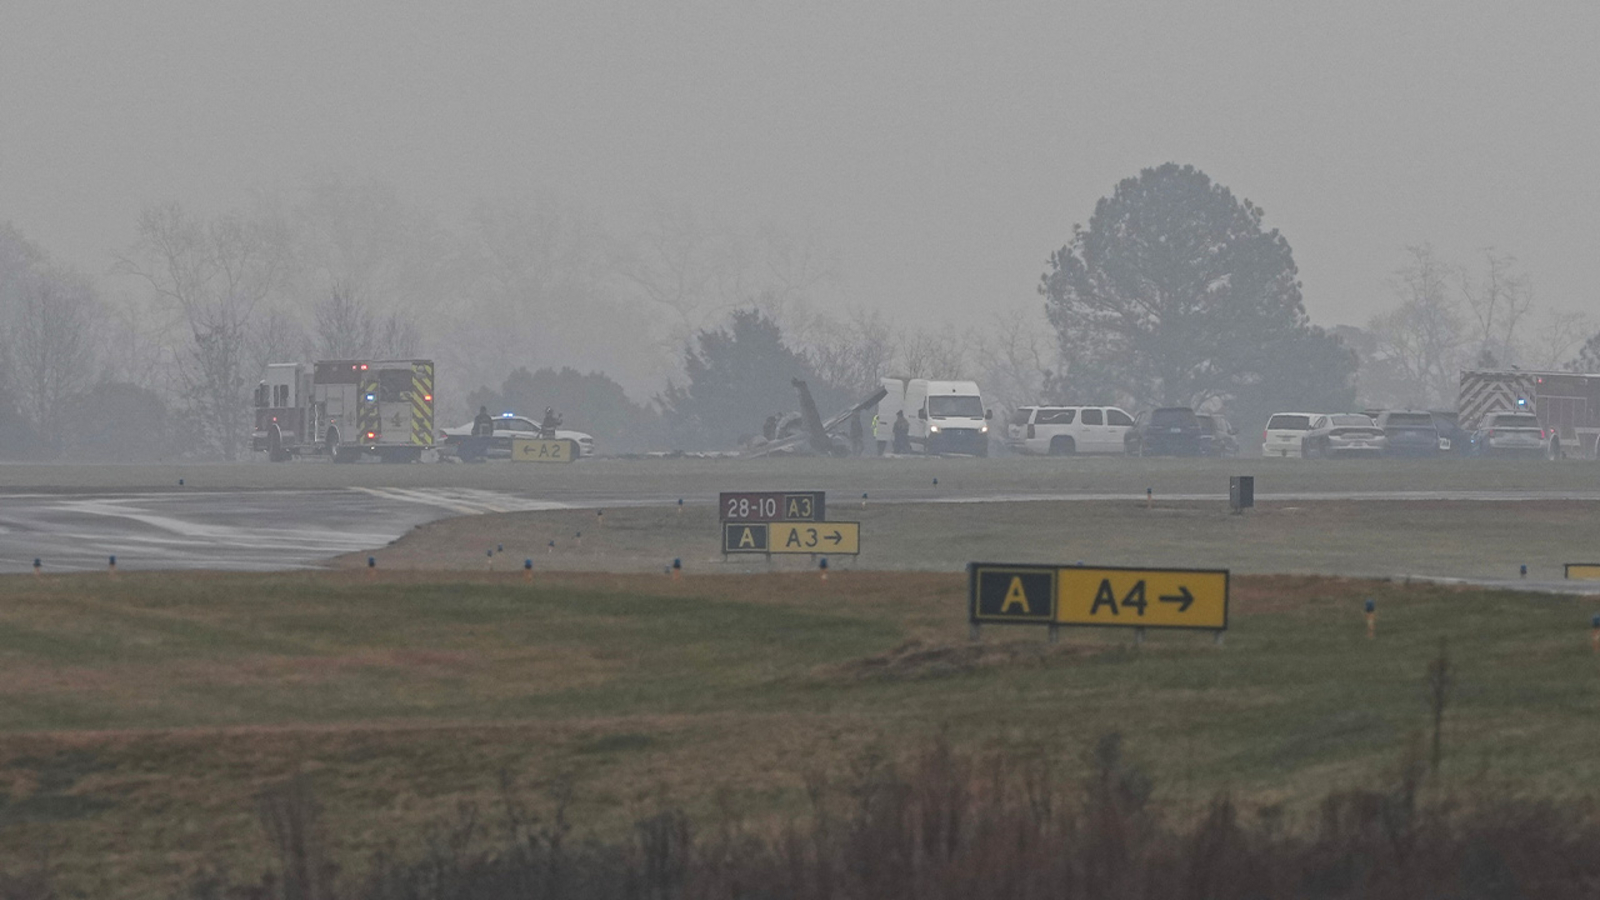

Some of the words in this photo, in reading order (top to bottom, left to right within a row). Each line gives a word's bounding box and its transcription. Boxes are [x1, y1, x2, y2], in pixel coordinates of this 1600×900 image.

[538, 444, 561, 458] A2
[728, 498, 776, 517] 28-10
[788, 498, 811, 517] A3
[739, 527, 755, 547] A
[785, 528, 818, 547] A3
[1001, 575, 1031, 613] A
[1089, 578, 1148, 616] A4
